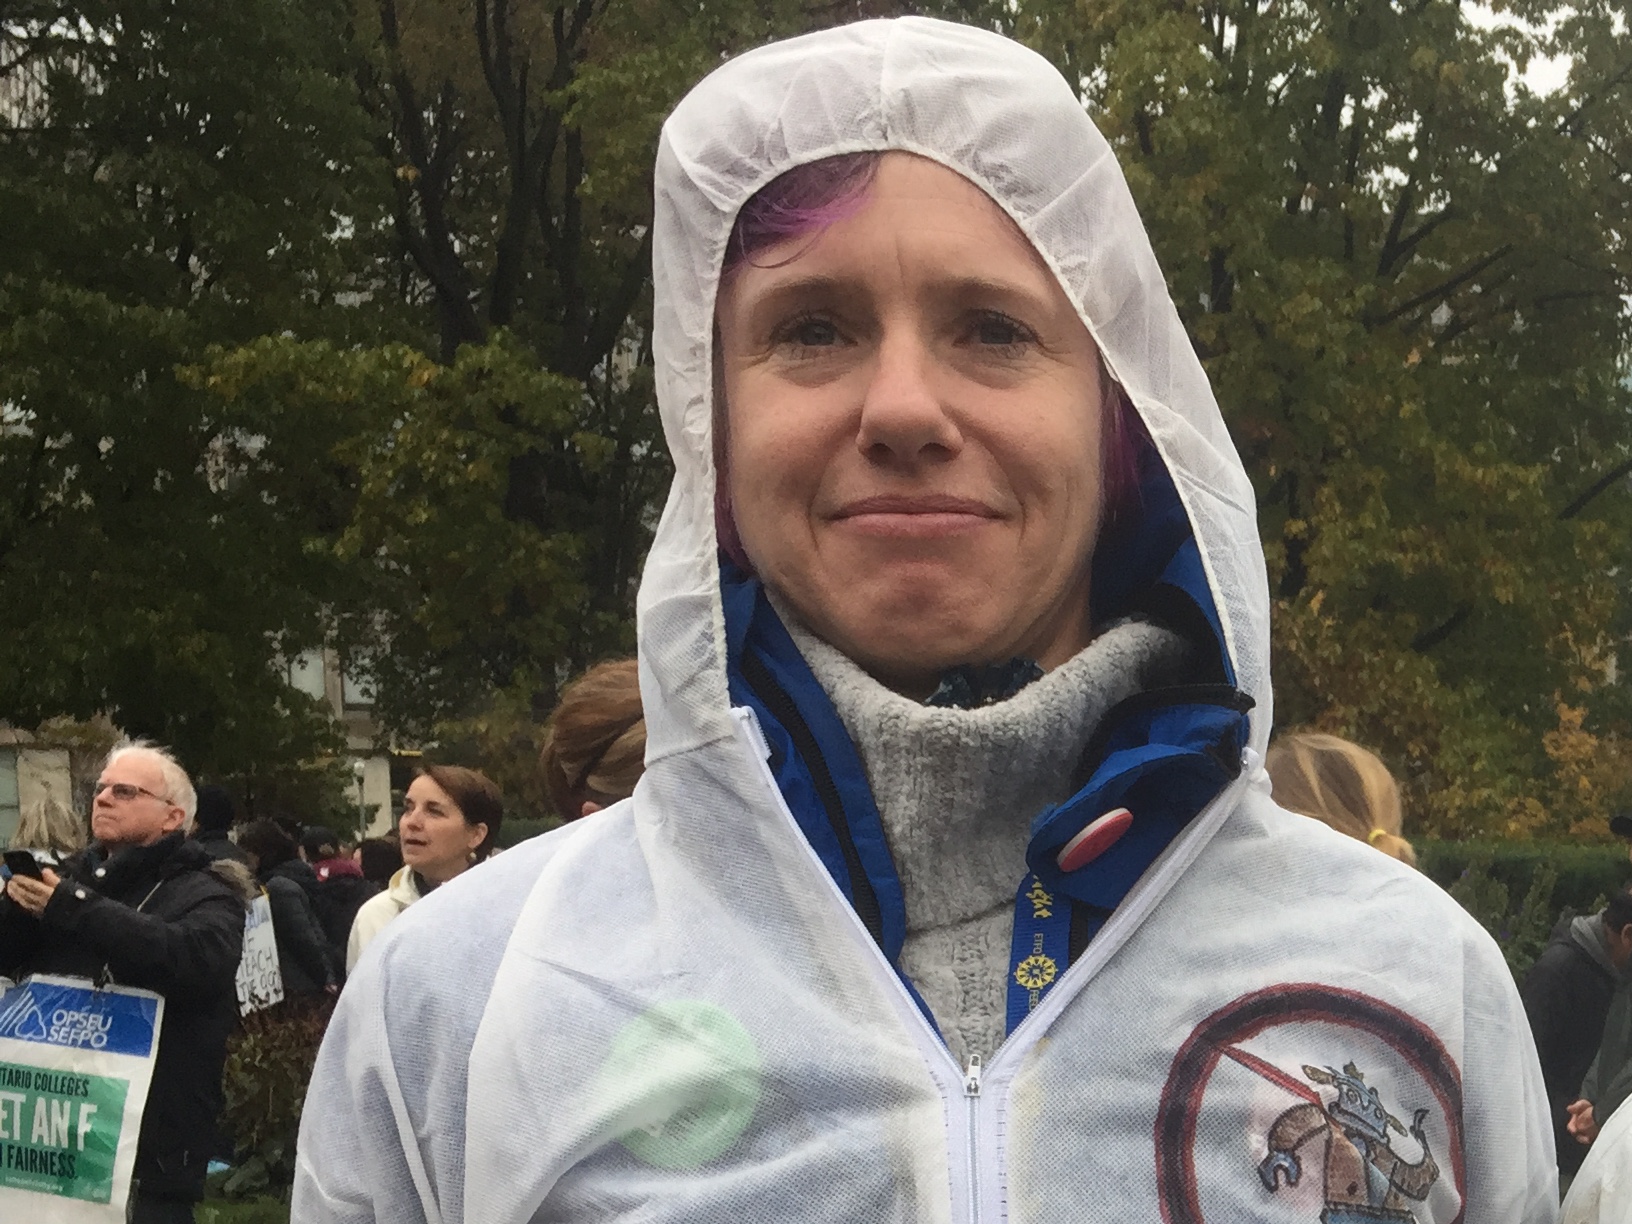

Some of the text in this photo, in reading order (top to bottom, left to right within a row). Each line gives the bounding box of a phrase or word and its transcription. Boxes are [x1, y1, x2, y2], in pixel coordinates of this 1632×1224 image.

[53, 1009, 113, 1032] OPSEU
[34, 1072, 89, 1098] COLLEGES
[31, 1096, 71, 1150] AN
